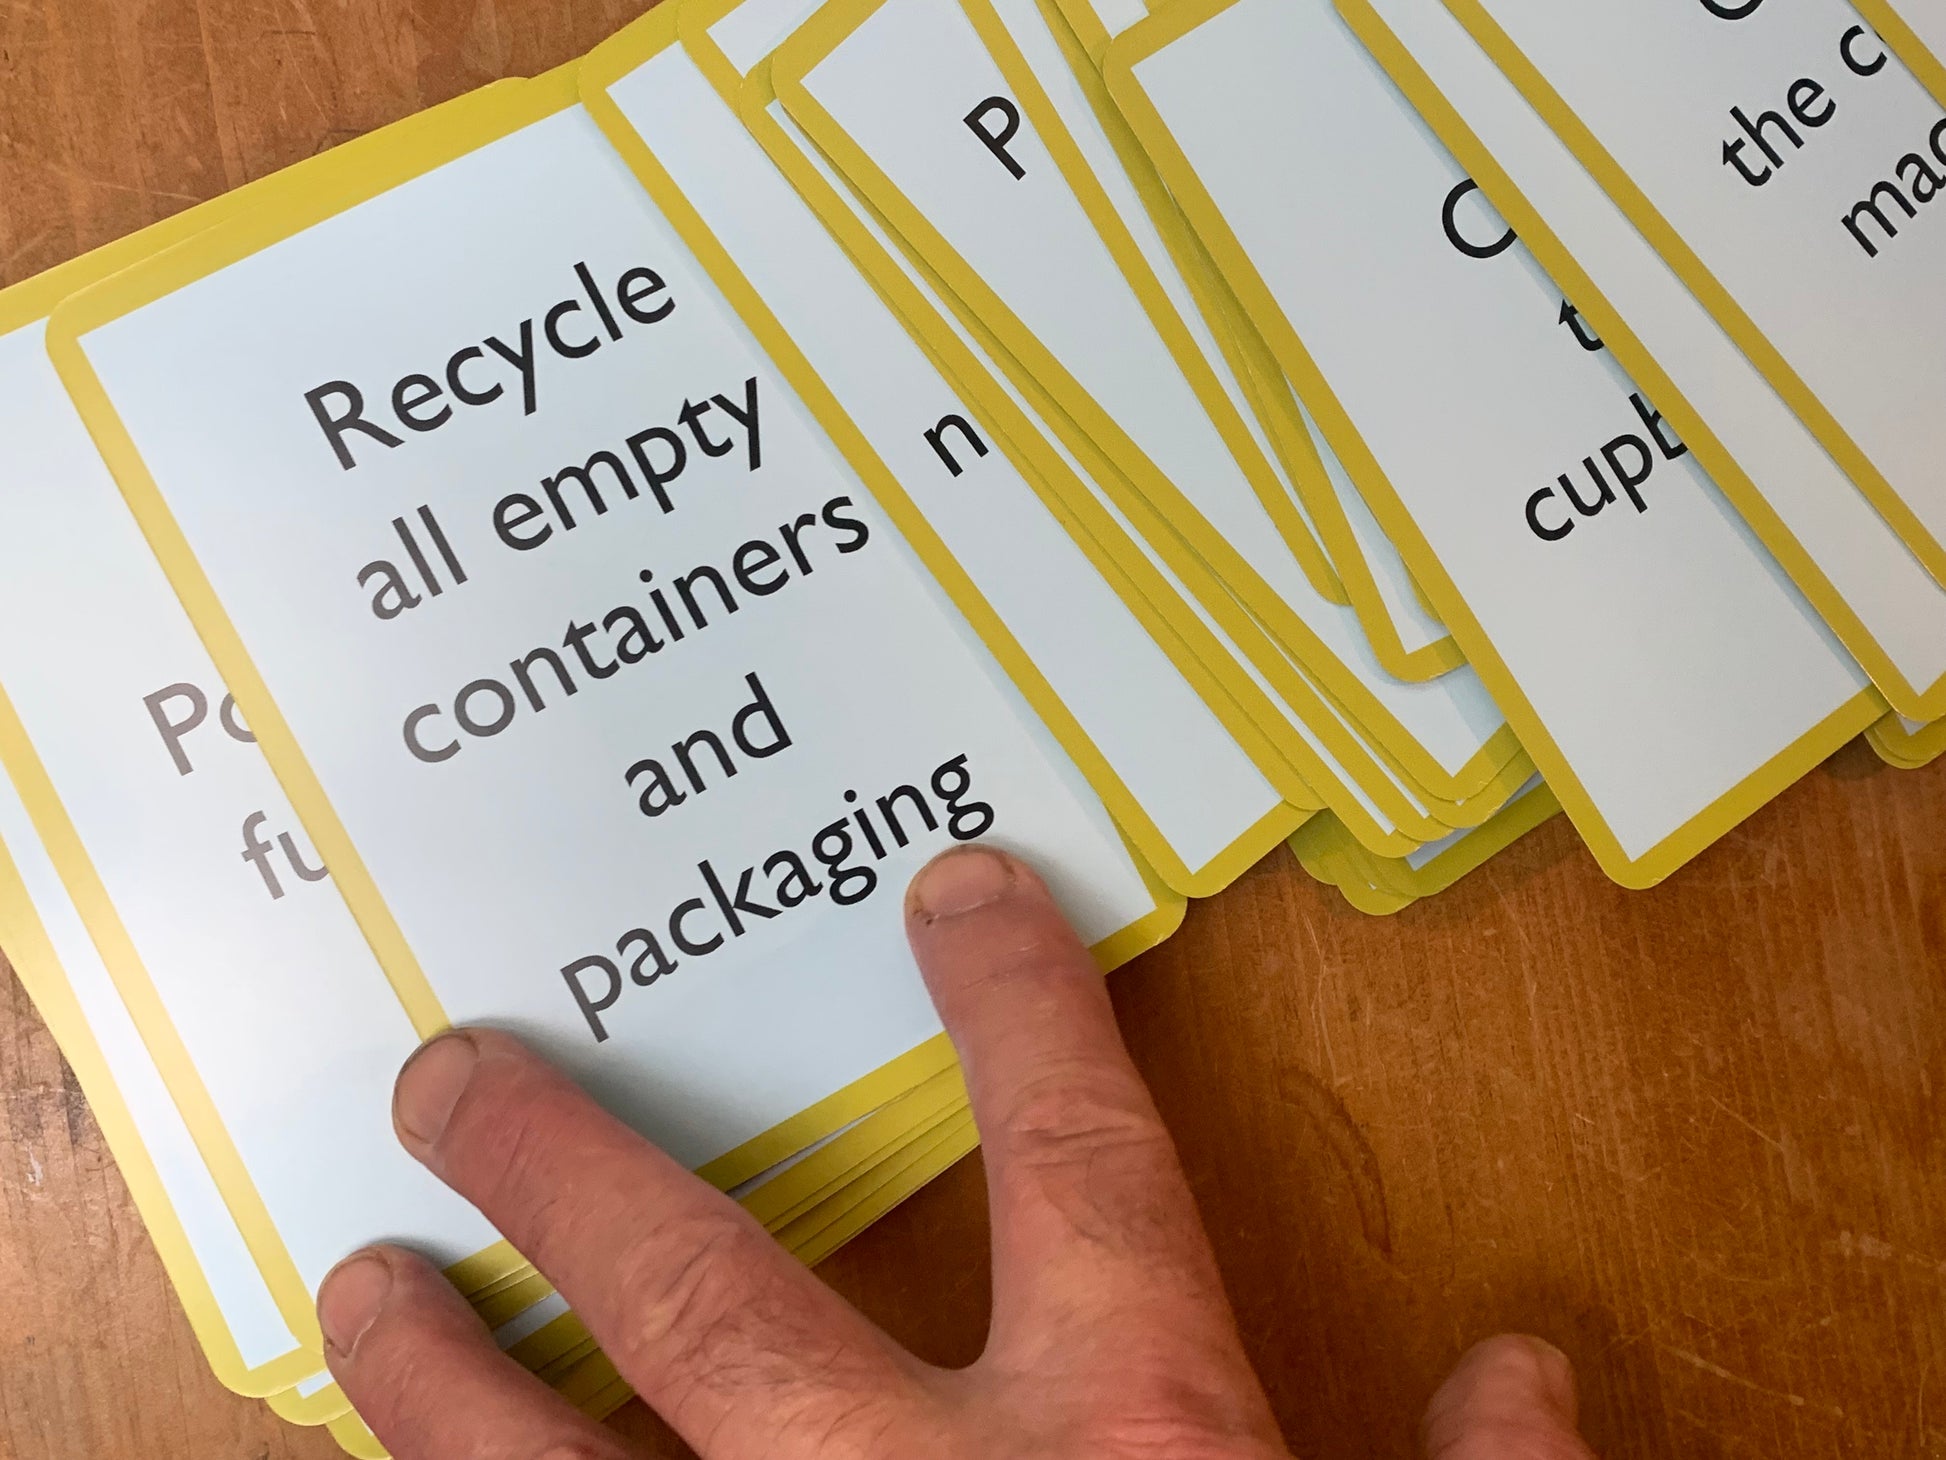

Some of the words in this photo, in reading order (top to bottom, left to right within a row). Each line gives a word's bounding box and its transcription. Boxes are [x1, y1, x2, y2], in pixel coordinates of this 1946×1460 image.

[962, 95, 1027, 182] P
[1722, 78, 1837, 187] the
[1840, 25, 1890, 77] c
[303, 260, 676, 471] Recycle
[356, 504, 469, 621] all
[492, 376, 763, 553] empty
[402, 495, 871, 763] containers
[624, 671, 794, 819] and
[560, 752, 996, 1044] packaging
